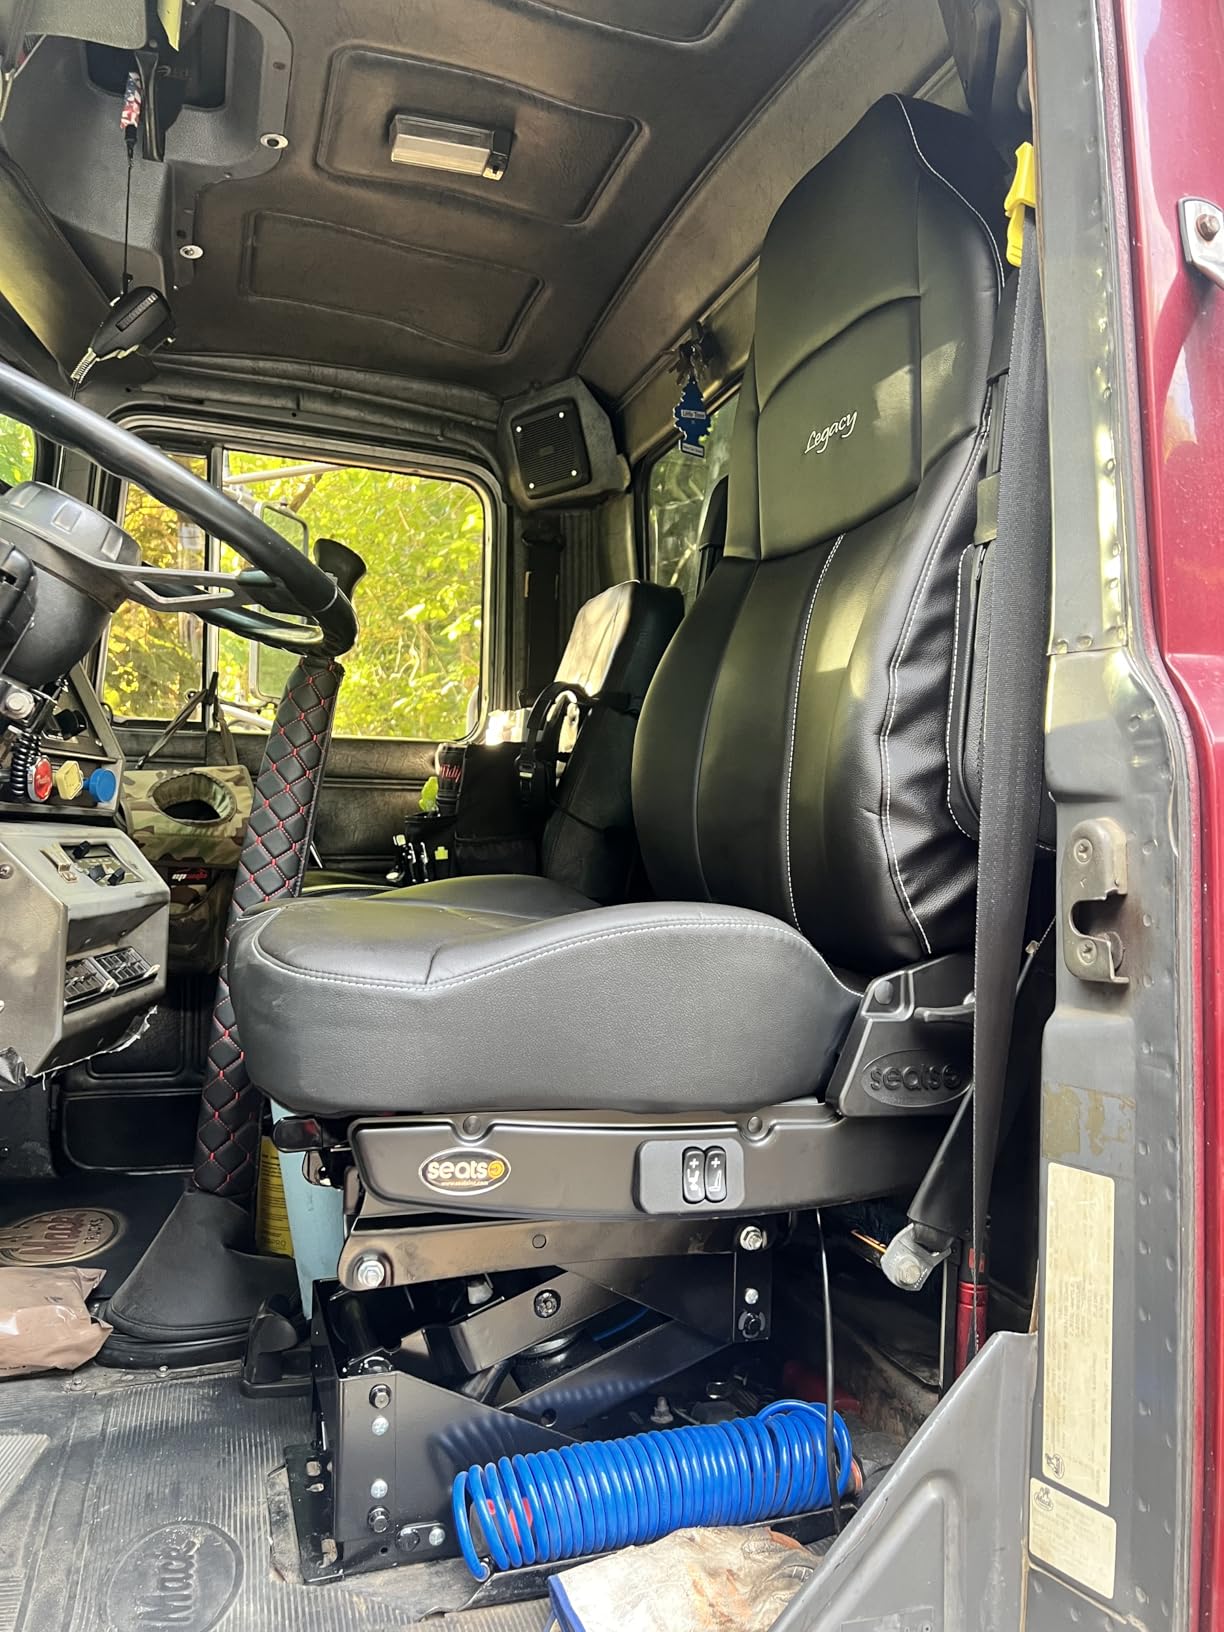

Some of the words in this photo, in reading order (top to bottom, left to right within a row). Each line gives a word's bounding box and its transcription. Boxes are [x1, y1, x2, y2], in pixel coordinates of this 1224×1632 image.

[804, 411, 858, 454] Legacy
[427, 1160, 488, 1180] seats
[19, 1212, 88, 1256] Mack
[135, 1539, 201, 1625] Mack
